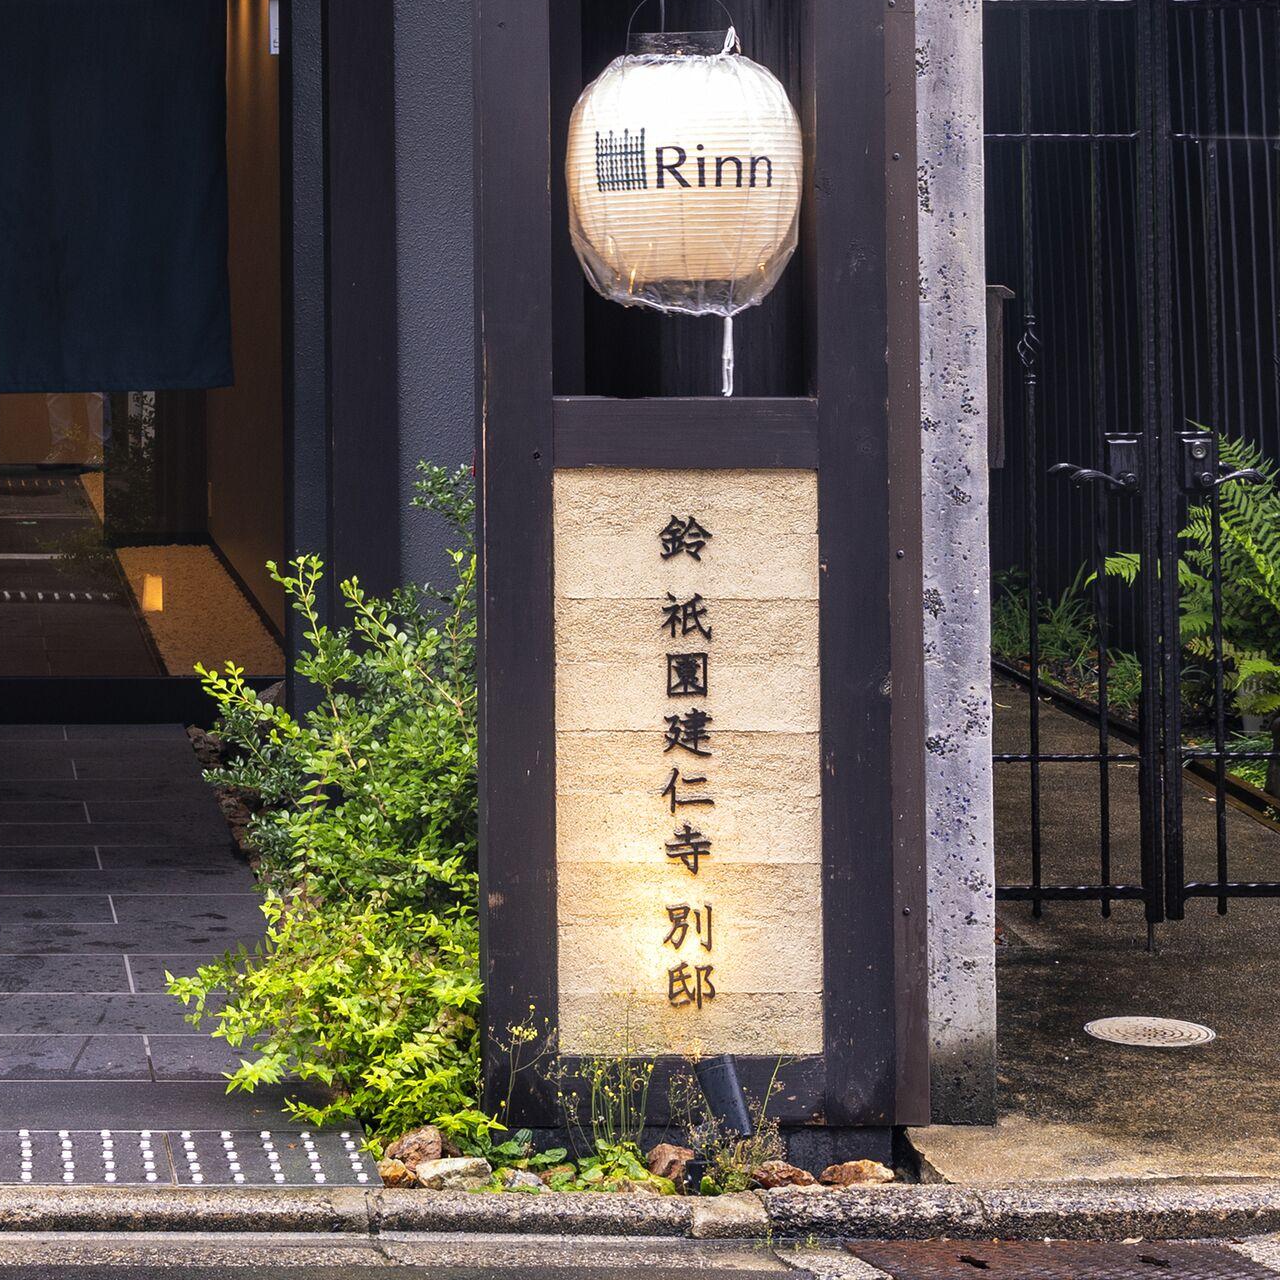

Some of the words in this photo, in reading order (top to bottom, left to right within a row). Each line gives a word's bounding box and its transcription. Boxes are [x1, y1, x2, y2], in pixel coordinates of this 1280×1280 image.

[655, 144, 773, 189] Rinn
[658, 514, 713, 562] 鈴
[663, 902, 717, 1011] 別邸
